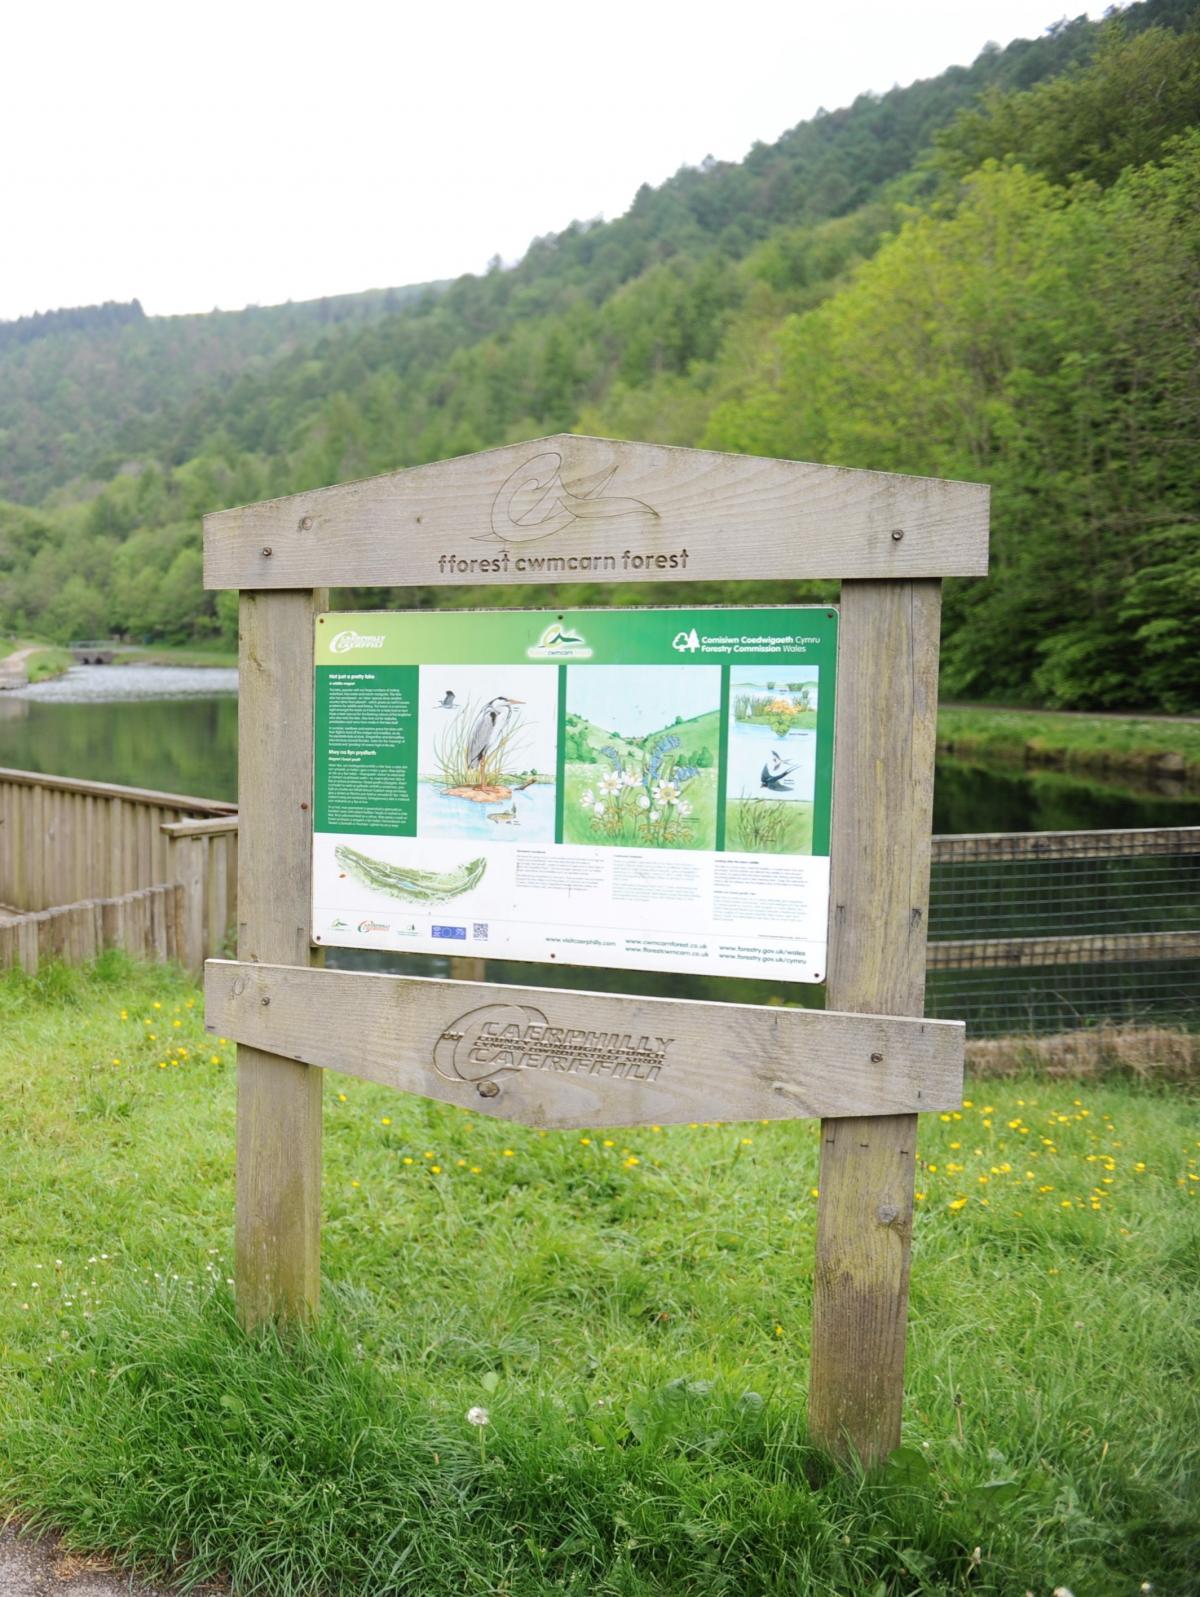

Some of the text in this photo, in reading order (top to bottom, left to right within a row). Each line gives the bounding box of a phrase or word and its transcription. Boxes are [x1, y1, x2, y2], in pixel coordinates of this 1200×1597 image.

[438, 548, 689, 573] fforest cwmcarn forest
[702, 636, 821, 646] Comisiwn Coedwigaeth Cymru
[701, 645, 732, 654] Forestry
[733, 645, 782, 653] Commission
[546, 936, 616, 947] www.visitcaerphilly.com
[625, 938, 707, 950] www.cwmcarnforest.co.uk
[625, 947, 709, 958] www.fforestcwmcarn.co.uk
[719, 945, 806, 956] www.forestry.gov.uk/wales
[719, 954, 807, 964] www.forestry.gov.uk/cymru
[481, 1021, 676, 1054] CAERPHILLY
[473, 1041, 527, 1053] CYNGOR
[476, 1035, 668, 1060] COUNTY BOROUGH COUNCIL
[467, 1047, 662, 1083] CAERFFILI
